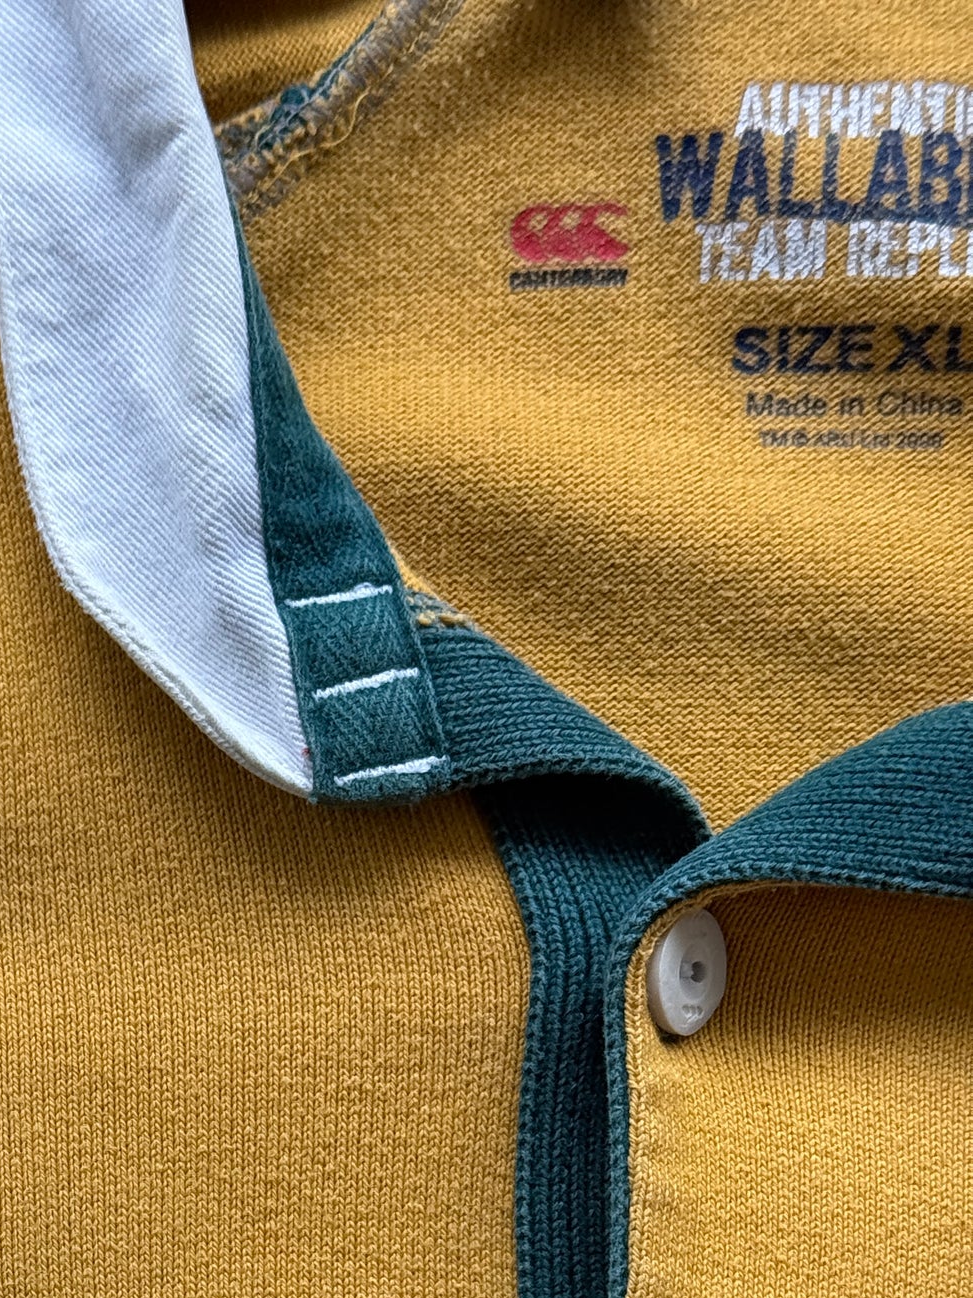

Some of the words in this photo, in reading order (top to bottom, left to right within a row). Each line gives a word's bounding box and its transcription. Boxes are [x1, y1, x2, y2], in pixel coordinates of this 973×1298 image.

[733, 80, 973, 140] AUTHENTI
[696, 218, 827, 284] TEAM
[731, 324, 875, 375] SIZE
[887, 324, 973, 372] XL
[745, 391, 827, 417] Made
[838, 392, 865, 416] in
[877, 391, 963, 417] China
